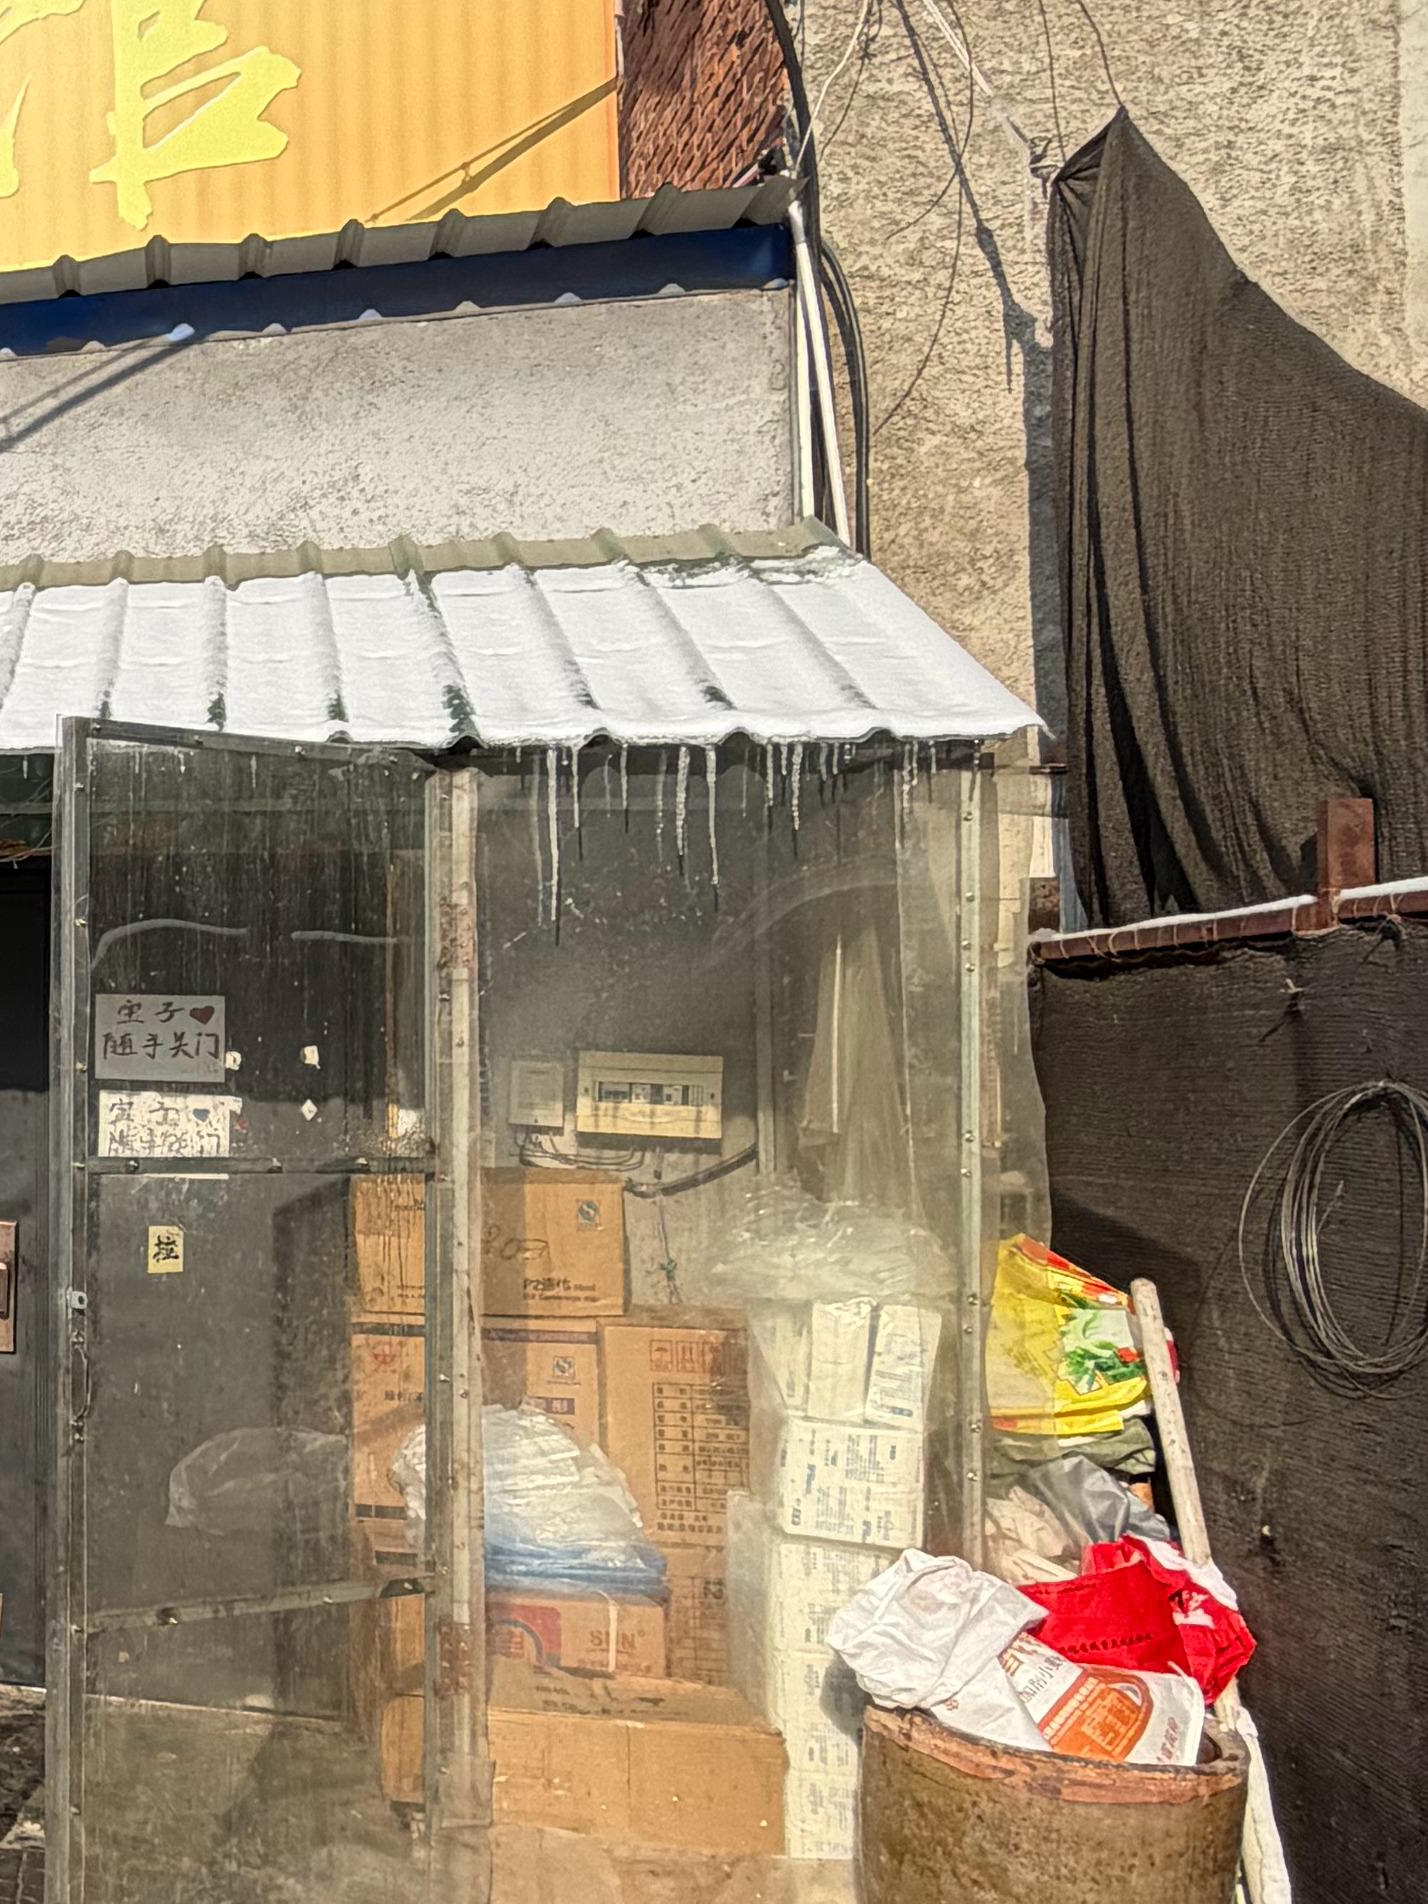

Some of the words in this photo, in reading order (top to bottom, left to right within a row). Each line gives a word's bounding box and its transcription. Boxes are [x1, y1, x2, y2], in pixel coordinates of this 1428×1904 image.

[117, 1000, 185, 1025] 宝子
[103, 1031, 220, 1060] 随手关门
